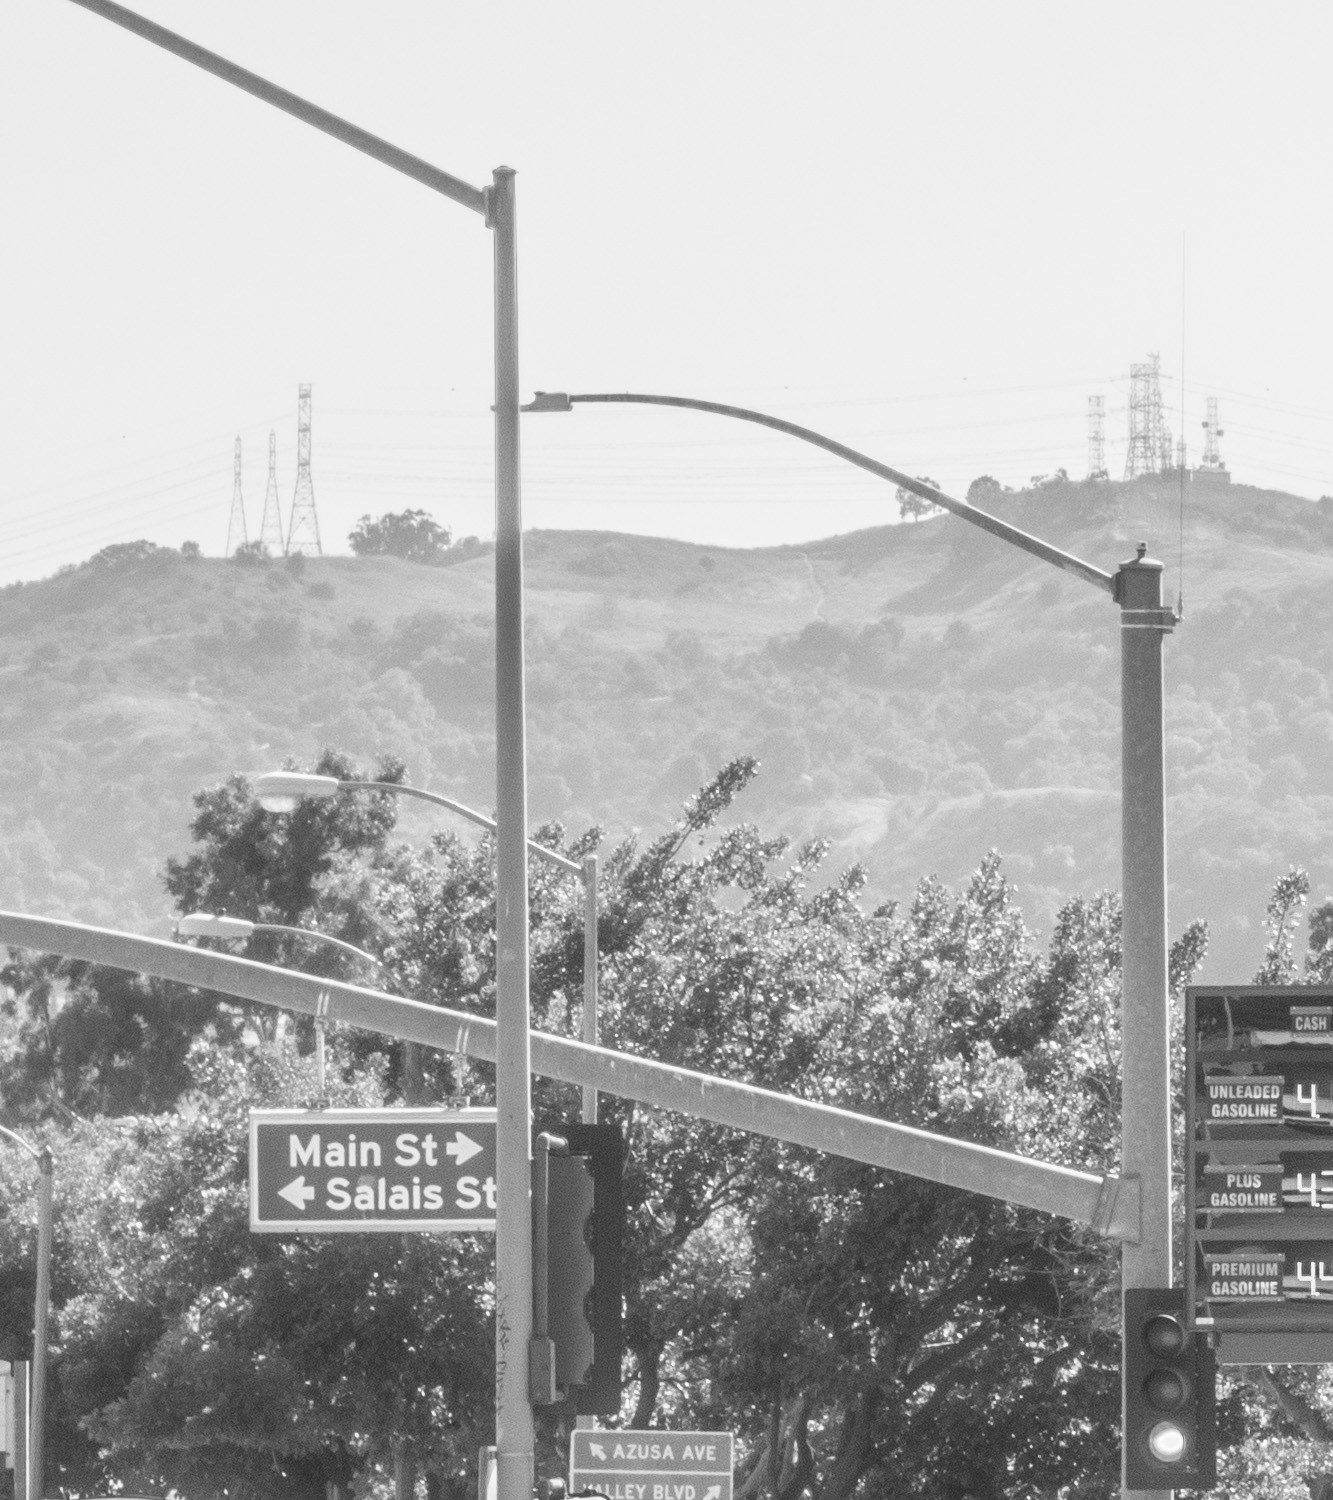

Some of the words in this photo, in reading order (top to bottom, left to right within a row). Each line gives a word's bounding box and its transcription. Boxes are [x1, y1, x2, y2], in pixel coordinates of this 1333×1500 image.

[1295, 1015, 1328, 1031] CASH
[1209, 1084, 1281, 1100] UNLEADED
[1211, 1103, 1278, 1119] GASOLINE
[289, 1134, 381, 1167] Main
[394, 1133, 438, 1167] St
[1226, 1173, 1262, 1189] PLUS
[326, 1176, 443, 1210] Salais
[455, 1176, 497, 1209] St
[1210, 1192, 1278, 1207] GASOLINE
[1211, 1262, 1279, 1277] PREMIUM
[1211, 1280, 1279, 1296] GASOLINE
[613, 1443, 674, 1461] AZUSA
[682, 1444, 717, 1461] AVE
[653, 1484, 696, 1500] BLVD
